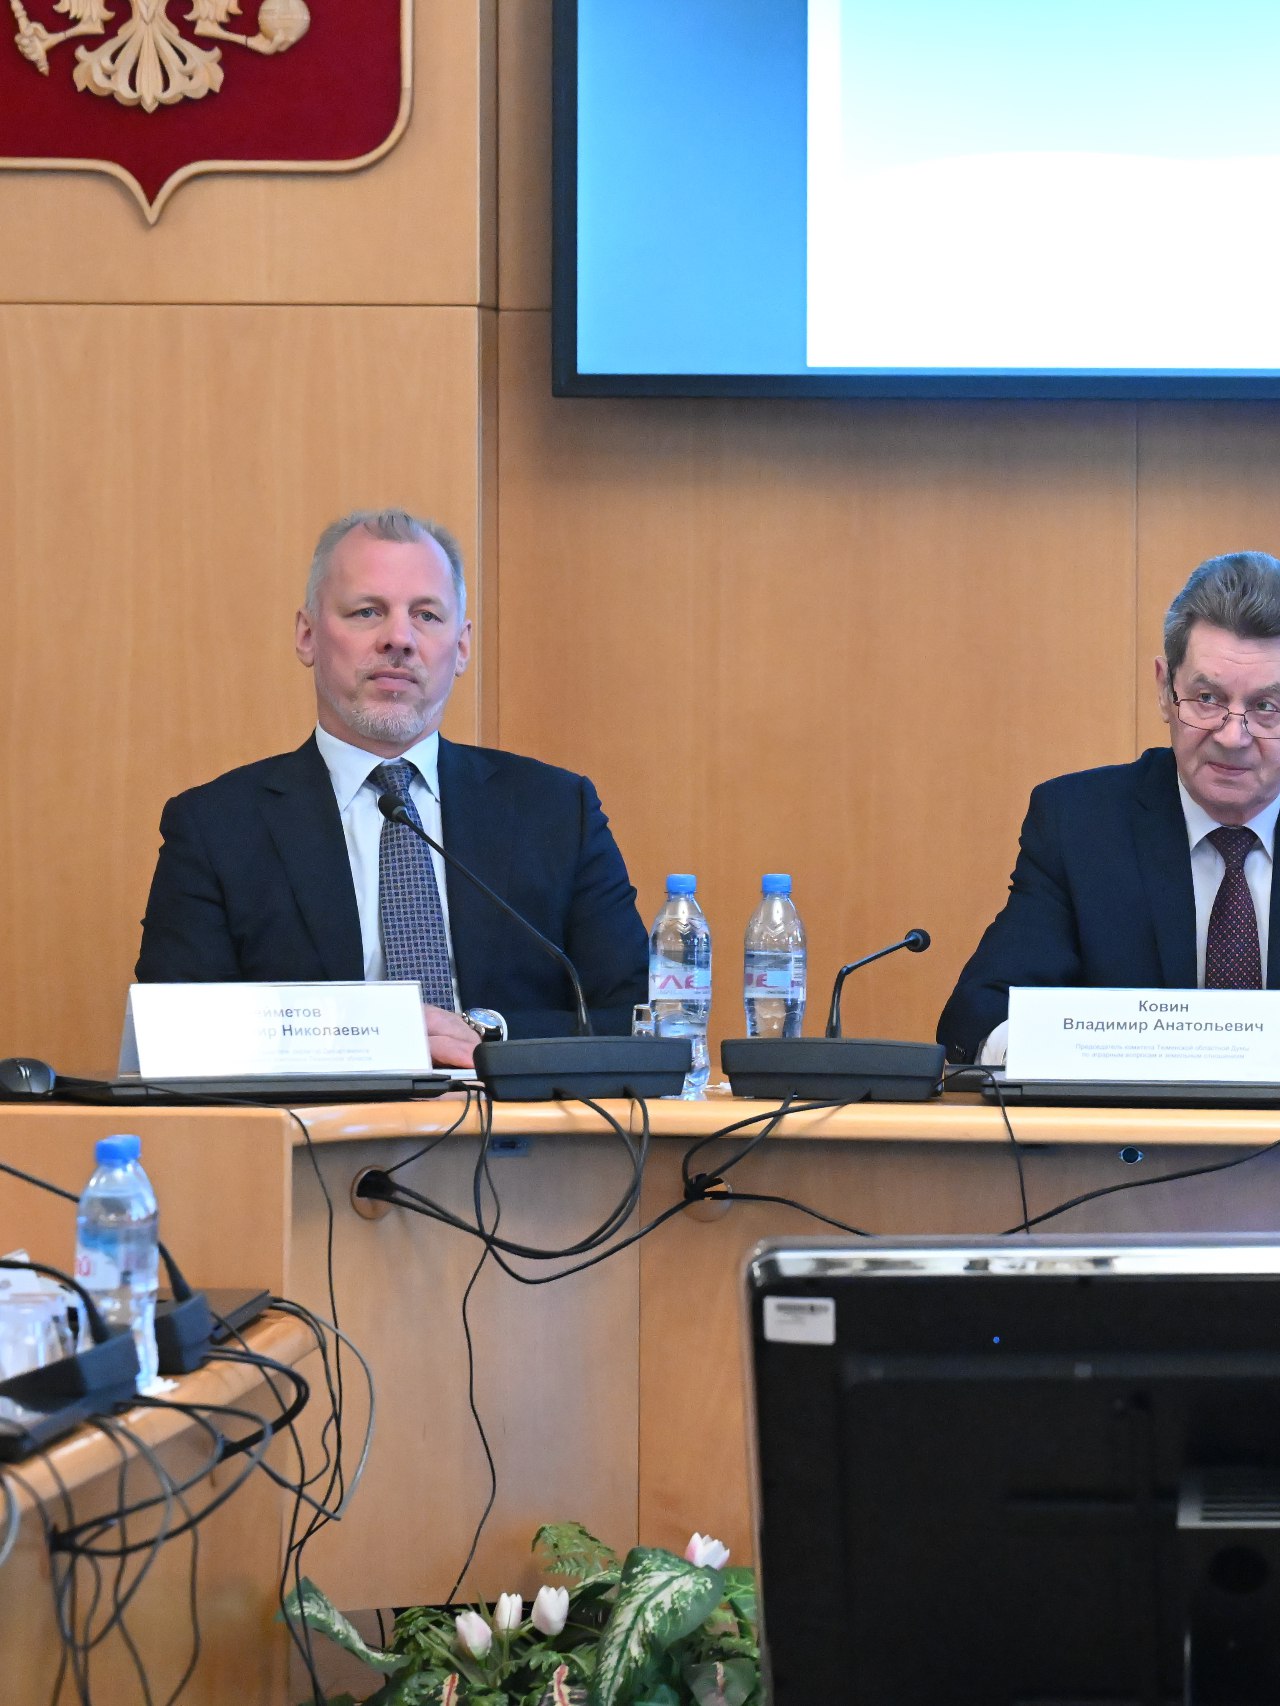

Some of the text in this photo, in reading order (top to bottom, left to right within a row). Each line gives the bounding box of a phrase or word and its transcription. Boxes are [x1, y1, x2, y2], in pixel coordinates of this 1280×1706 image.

[1139, 1000, 1189, 1013] Ковин
[282, 1024, 380, 1037] Николаевич
[1063, 1017, 1264, 1033] Владимир Анатольевич
